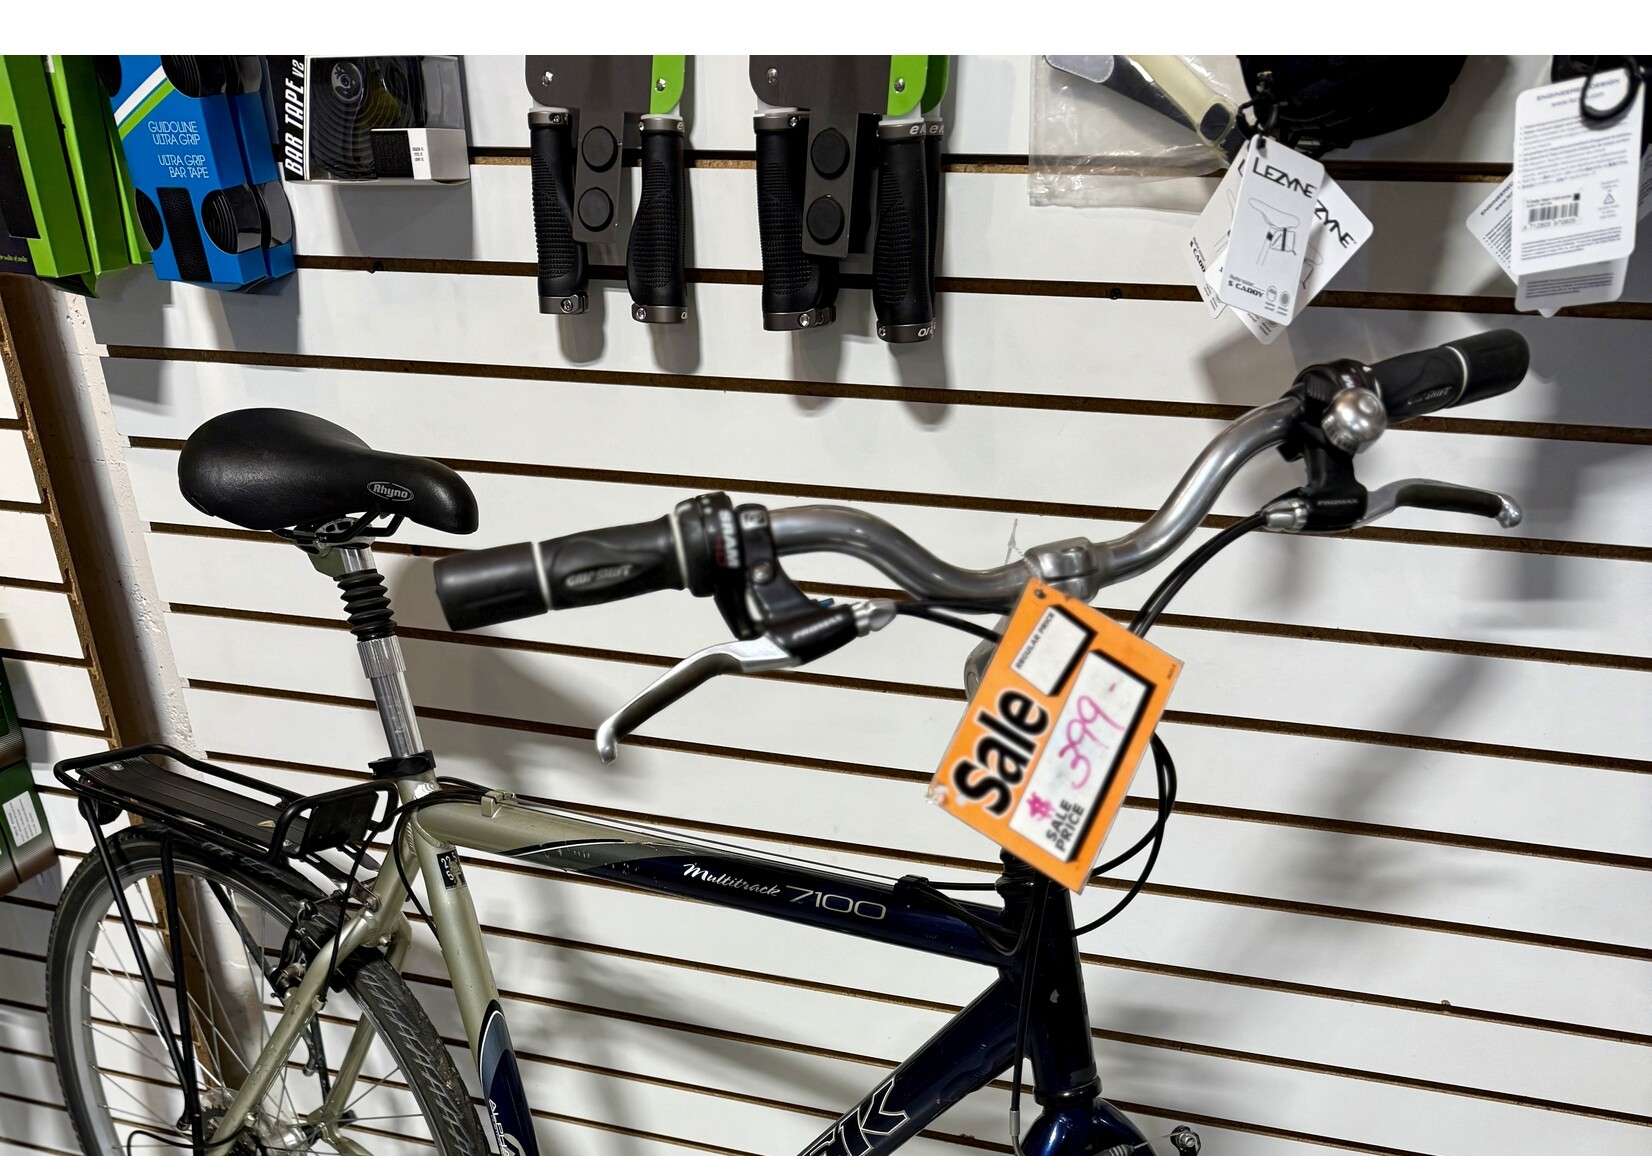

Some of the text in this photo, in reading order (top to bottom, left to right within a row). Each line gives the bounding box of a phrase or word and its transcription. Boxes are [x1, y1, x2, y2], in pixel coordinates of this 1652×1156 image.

[147, 120, 199, 133] GUIDOLINE
[152, 133, 201, 145] ULTRA GRIP
[284, 59, 304, 177] BAR TAPE V2
[157, 154, 206, 166] ULTRA GRIP
[168, 166, 210, 178] BAR TAPE
[1252, 156, 1317, 198] LEZYNE
[1314, 199, 1356, 249] ZYNE
[1234, 282, 1265, 298] CADDY
[372, 483, 409, 499] Rhyno
[1015, 610, 1056, 670] REGULAR PRICE
[952, 689, 1051, 817] Sale
[1046, 798, 1074, 842] SALE
[1054, 803, 1086, 853] PRICE
[682, 862, 888, 920] Multitrack 7100
